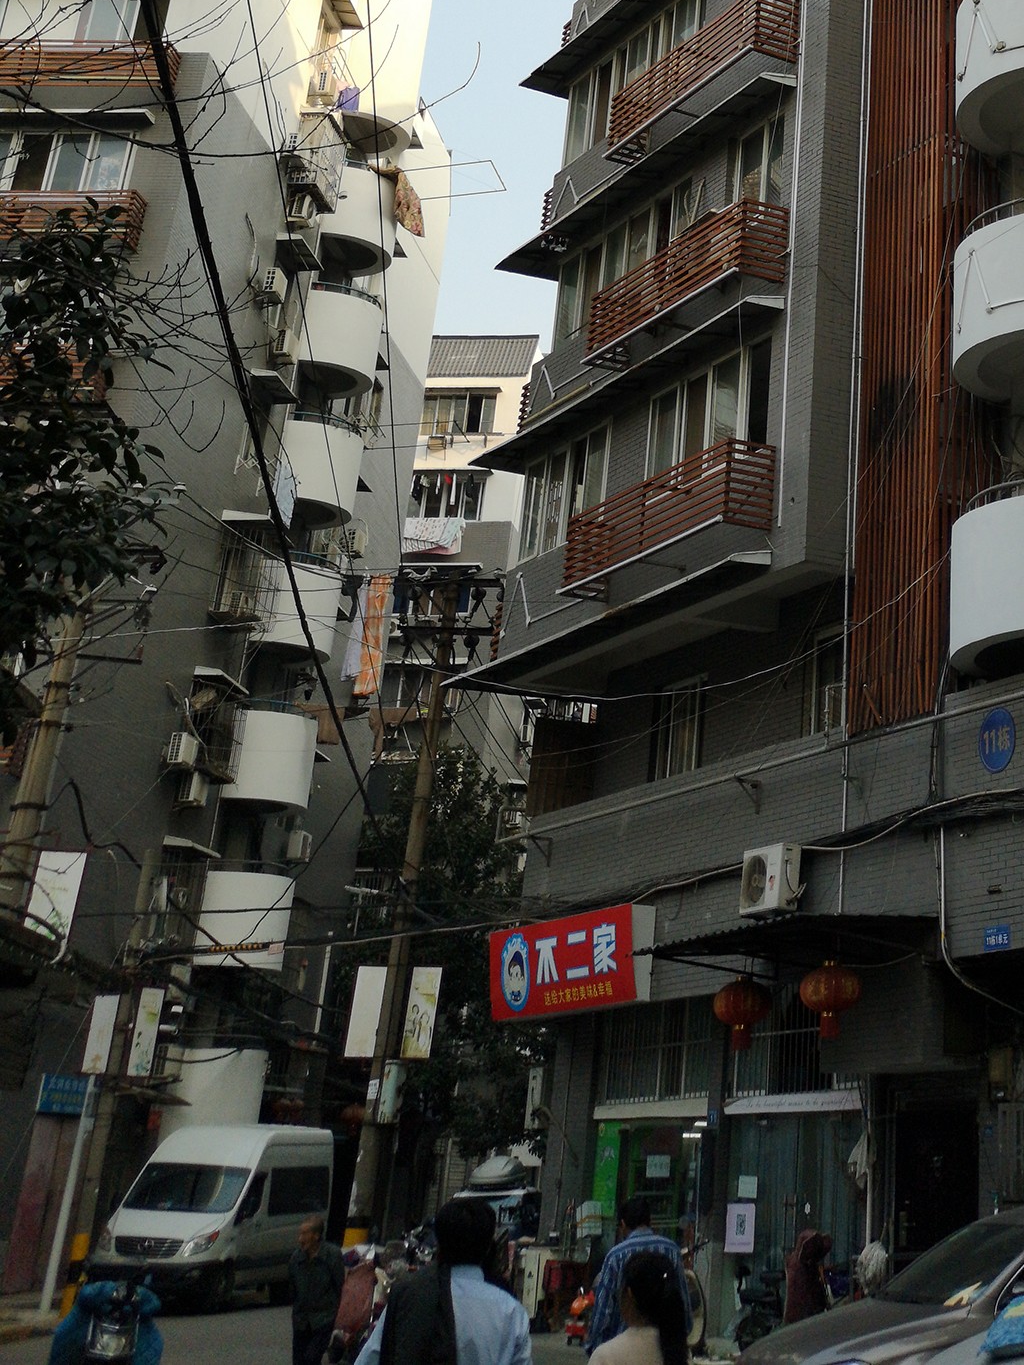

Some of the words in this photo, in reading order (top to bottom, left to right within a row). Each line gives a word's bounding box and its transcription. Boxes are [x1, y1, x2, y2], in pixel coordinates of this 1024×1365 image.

[535, 922, 618, 986] 不二家
[544, 981, 613, 1007] 送给大家的美味&幸福
